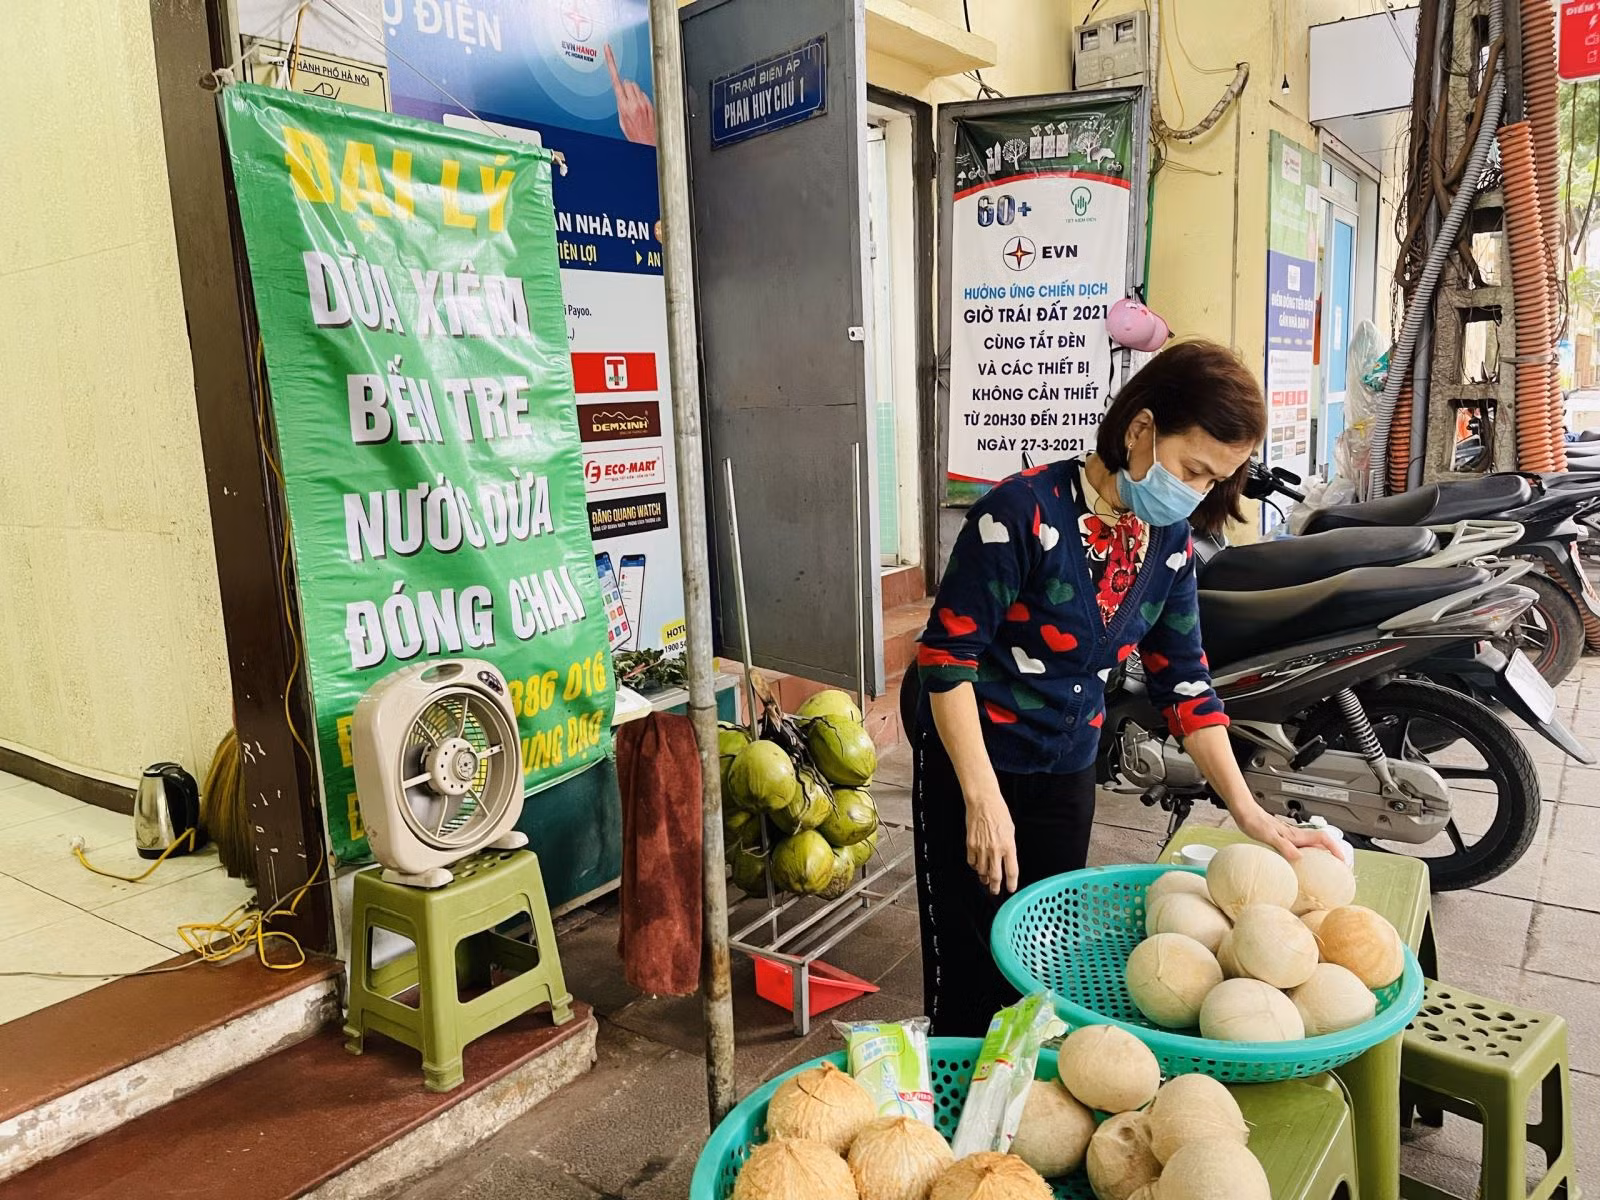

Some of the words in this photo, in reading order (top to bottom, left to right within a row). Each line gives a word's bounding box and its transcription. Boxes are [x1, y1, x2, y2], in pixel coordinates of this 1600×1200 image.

[413, 0, 501, 55] ĐIỆN
[296, 61, 321, 74] HÀNH
[323, 65, 340, 78] PHỐ
[341, 69, 353, 82] HÀ
[724, 97, 749, 128] PHAN
[752, 88, 772, 119] HUY
[773, 76, 795, 112] CHÚ
[799, 77, 804, 103] 1
[282, 125, 416, 233] ĐẠI
[440, 154, 516, 232] LÝ
[977, 194, 1032, 227] 60+
[575, 213, 614, 237] NHÀ
[616, 219, 650, 245] BẠN
[558, 240, 578, 264] IỆN
[580, 244, 597, 266] LỢI
[1042, 245, 1078, 259] EVN
[409, 259, 532, 337] XIÊM
[964, 283, 1006, 300] HƯỞNG
[1010, 283, 1035, 299] ỨNG
[1039, 280, 1075, 297] CHIẾN
[1079, 282, 1108, 299] DỊCH
[568, 304, 592, 318] Payoo.
[964, 304, 994, 323] GIỜ
[998, 304, 1031, 322] TRÁI
[1037, 300, 1067, 321] ĐẤT
[1073, 305, 1108, 320] 2021
[983, 333, 1026, 349] CÙNG
[1030, 330, 1054, 349] TẮT
[1058, 331, 1086, 348] ĐÈN
[978, 360, 997, 375] VÀ
[1001, 360, 1033, 375] CÁC
[1038, 356, 1073, 375] THIẾT
[1077, 361, 1090, 377] BỊ
[346, 354, 445, 444] BẾN
[444, 375, 533, 442] TRE
[972, 385, 1024, 400] KHÔNG
[1028, 382, 1060, 400] CẦN
[1064, 382, 1099, 399] THIẾT
[592, 421, 648, 432] DEMXINH
[964, 410, 980, 426] TỪ
[983, 413, 1026, 426] 20H30
[1031, 408, 1058, 426] ĐẾN
[977, 436, 1017, 451] NGÀY
[1021, 438, 1084, 451] 27-3-2021
[605, 461, 656, 476] ECO-MART
[343, 472, 486, 562] NƯỚC
[477, 467, 554, 546] DỪA
[612, 506, 636, 522] QUANG
[636, 502, 661, 519] WATCH
[345, 579, 496, 671] ĐÓNG
[508, 565, 586, 641] CHAI
[664, 643, 680, 653] 1900
[563, 651, 607, 701] 016
